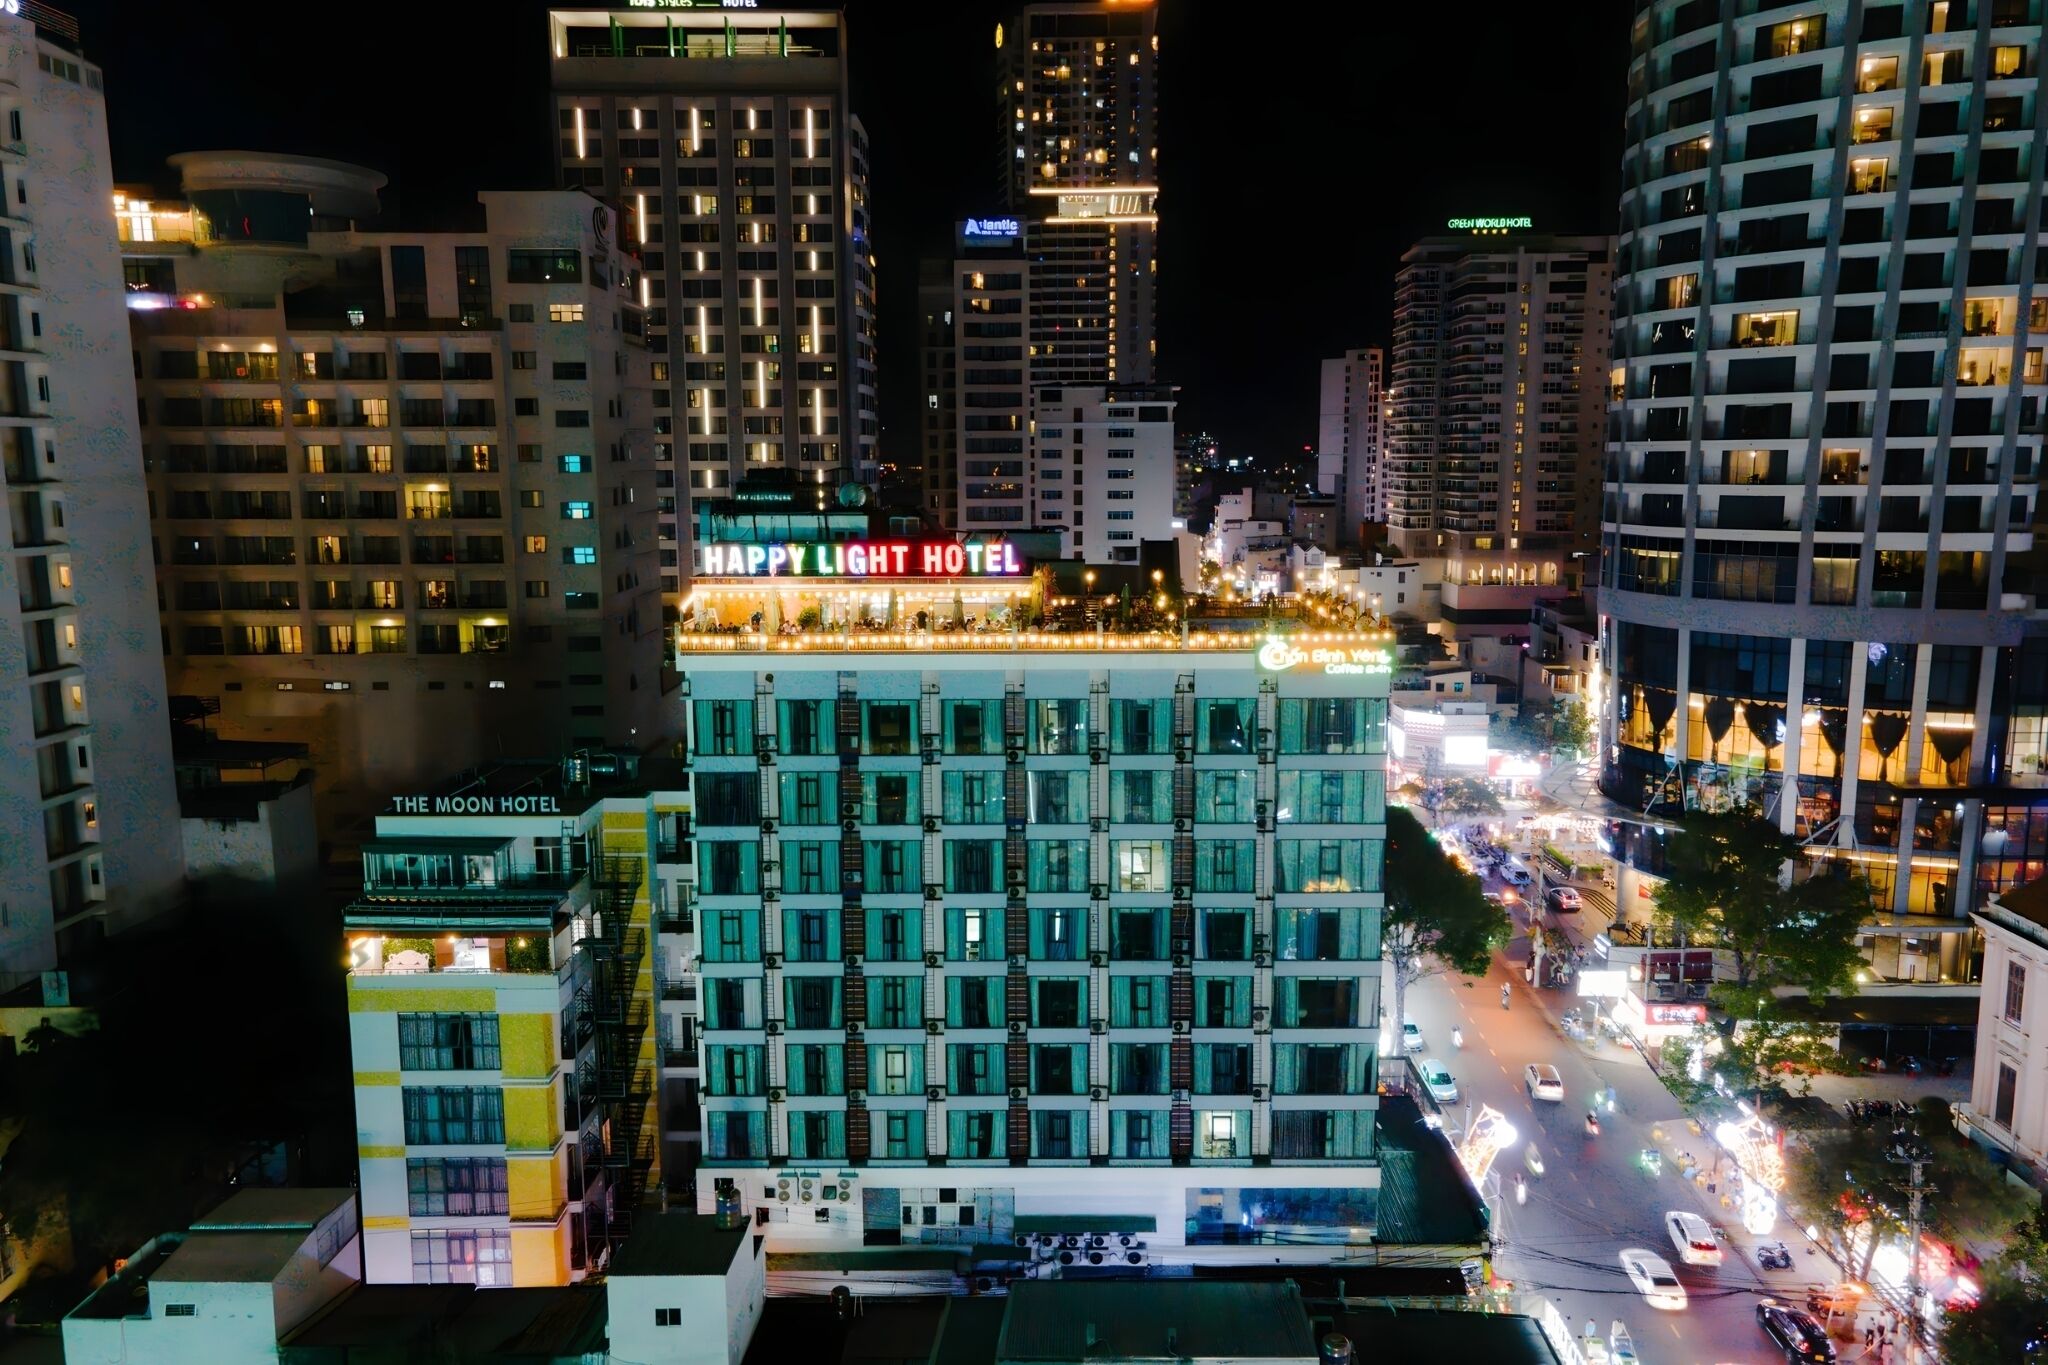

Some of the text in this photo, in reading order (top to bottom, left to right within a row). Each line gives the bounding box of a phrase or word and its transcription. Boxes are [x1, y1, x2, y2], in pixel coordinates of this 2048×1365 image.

[965, 218, 1018, 235] Atlantic
[1448, 217, 1532, 228] GREEN WORLD HOTEL
[704, 544, 1020, 574] HAPPY LIGHT HOTEL
[1325, 663, 1392, 674] Coffee 24h
[392, 796, 561, 813] THE MOON HOTEL
